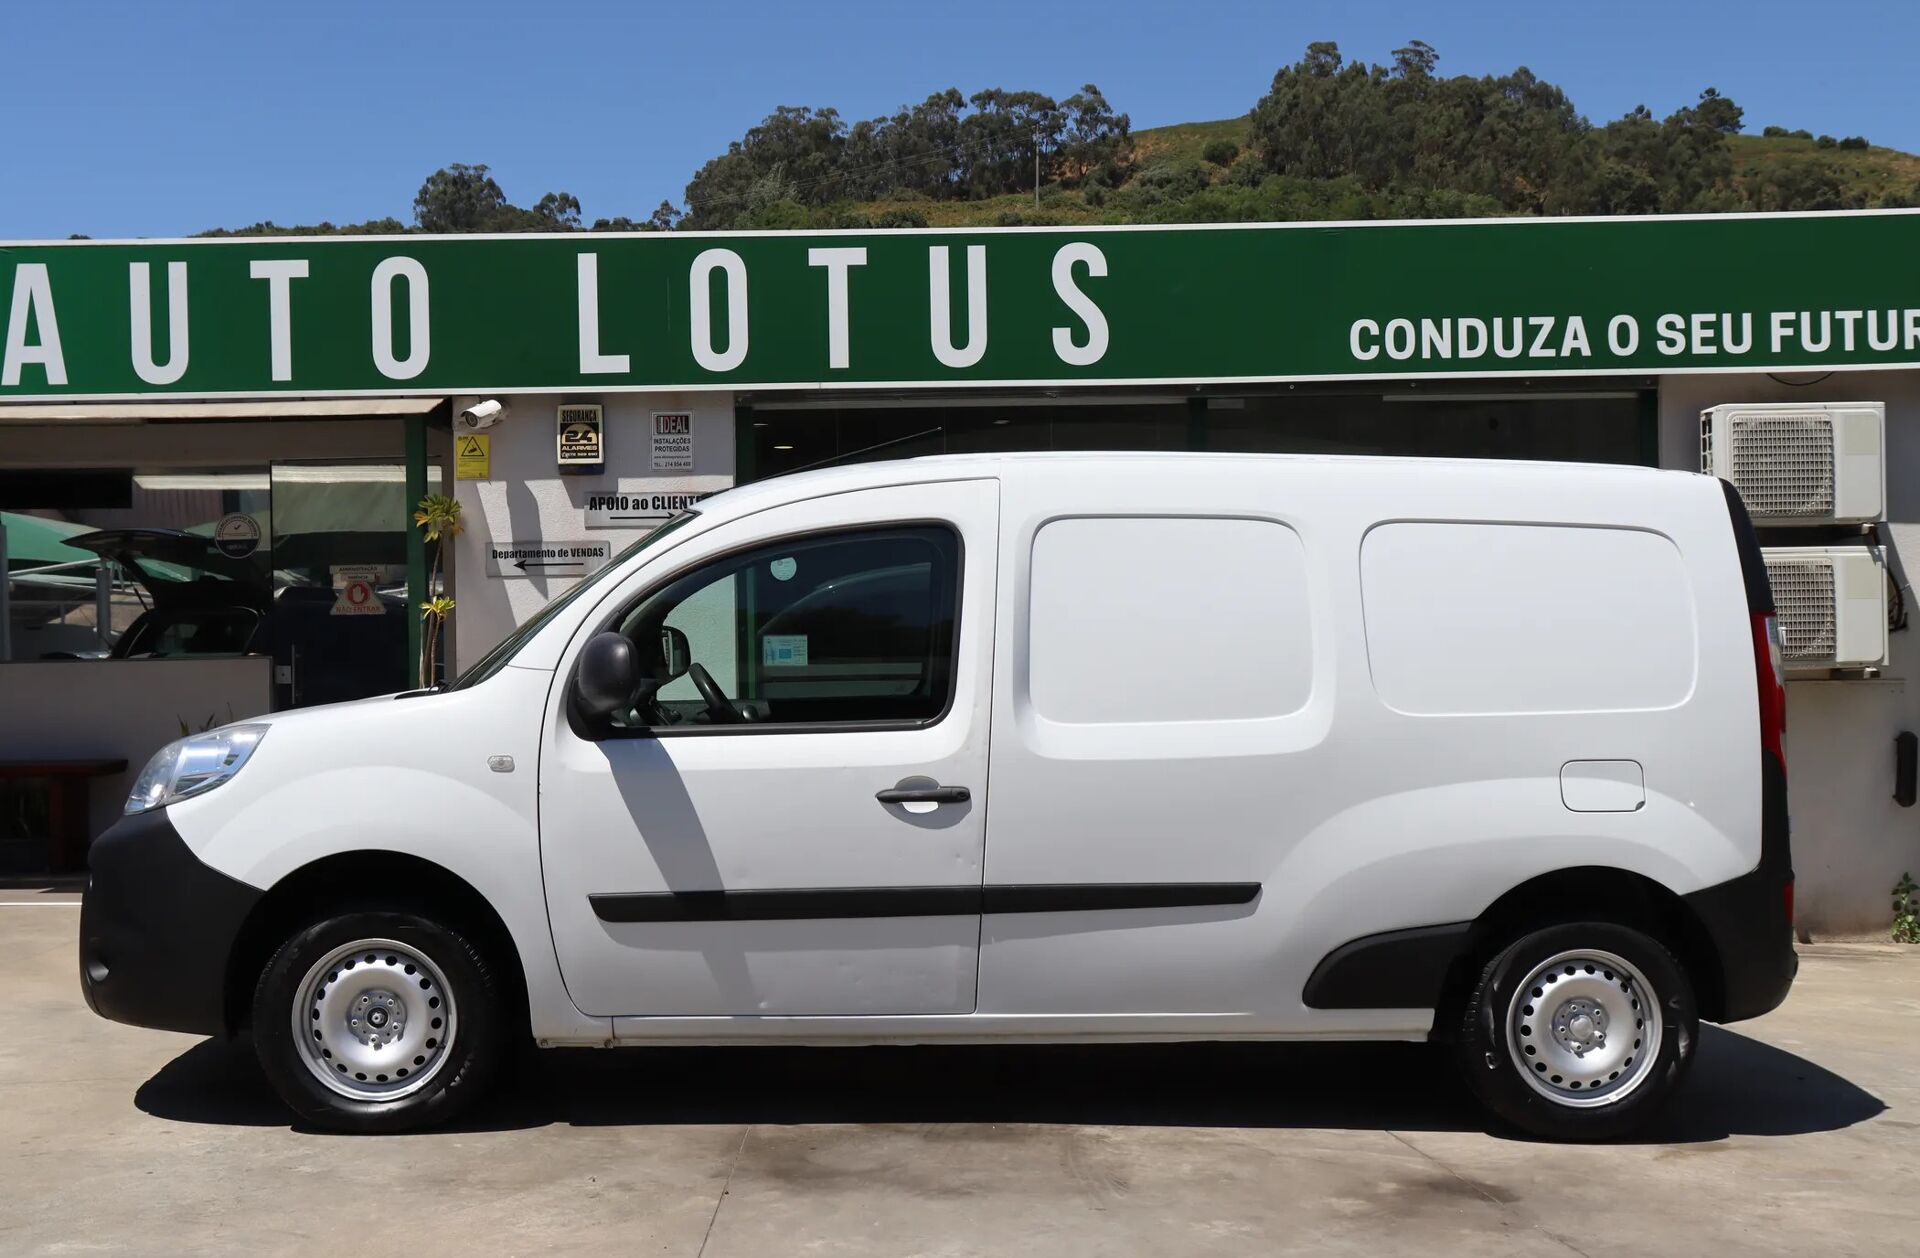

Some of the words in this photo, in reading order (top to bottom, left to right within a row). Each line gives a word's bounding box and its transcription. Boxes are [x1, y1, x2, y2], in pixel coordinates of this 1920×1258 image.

[1, 255, 431, 386] AUTO
[577, 241, 1109, 374] LOTUS
[1349, 315, 1592, 361] CONDUZA
[1607, 314, 1640, 356] O
[1655, 312, 1753, 356] SEU
[561, 409, 597, 422] SEGURANÇA
[660, 416, 689, 433] IDEAL
[564, 430, 593, 442] 24
[653, 436, 691, 444] INSTALAÇÕES
[589, 496, 628, 510] APOIO
[632, 498, 648, 510] ao
[492, 548, 556, 559] Departamento
[557, 548, 569, 558] de
[570, 547, 604, 558] VENDAS
